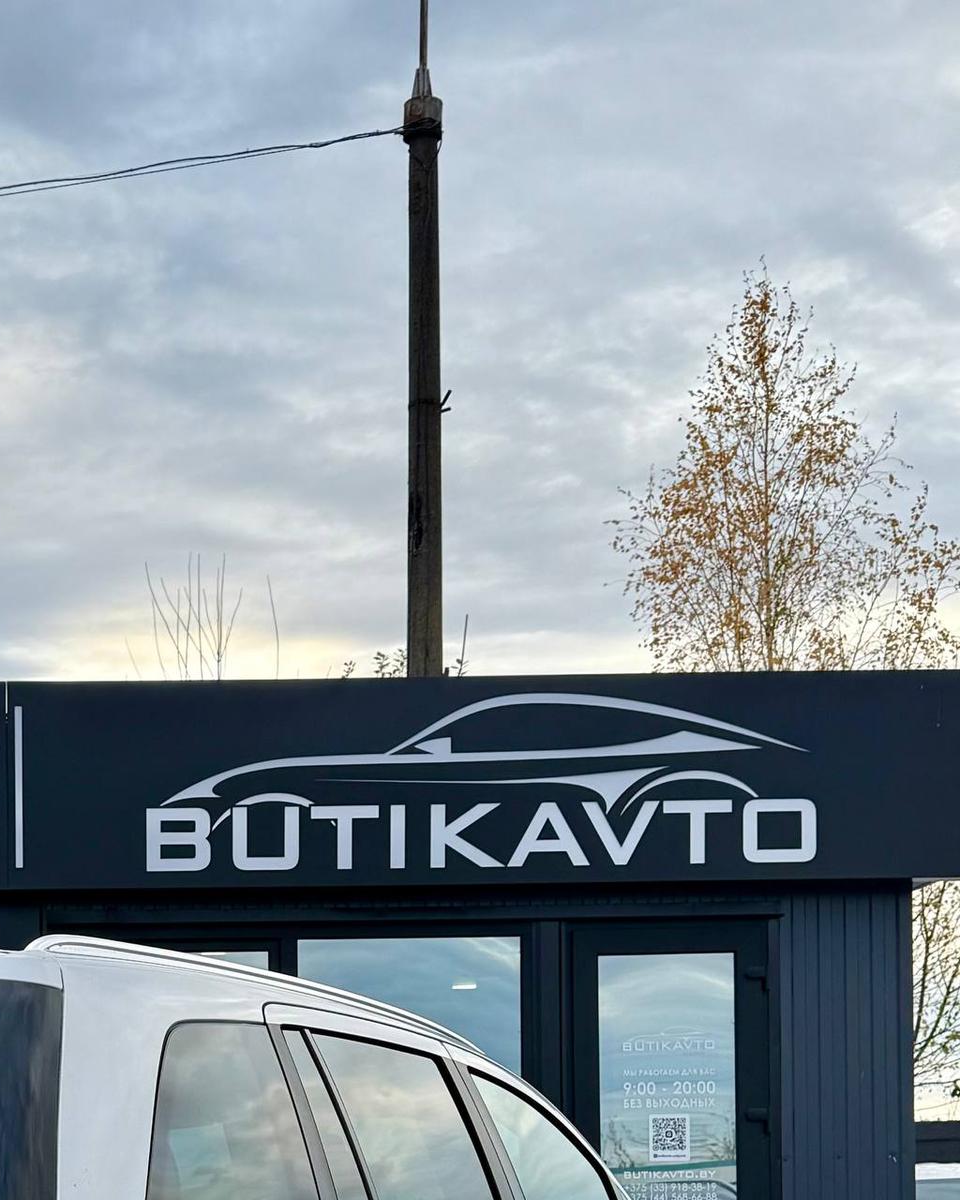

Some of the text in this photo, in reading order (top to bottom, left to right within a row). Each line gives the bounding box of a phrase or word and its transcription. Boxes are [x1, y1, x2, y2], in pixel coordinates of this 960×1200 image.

[145, 797, 818, 873] BUTIKAVTO
[622, 1039, 716, 1052] BUTIKAVTO
[623, 1081, 656, 1096] 9:00
[673, 1080, 716, 1095] 20:00
[623, 1097, 716, 1109] БЕЗ ВЫХОДНЫХ
[623, 1170, 717, 1180] BUTIKAVTO.BY
[650, 1183, 668, 1193] (33)
[670, 1182, 717, 1192] 918-38-19
